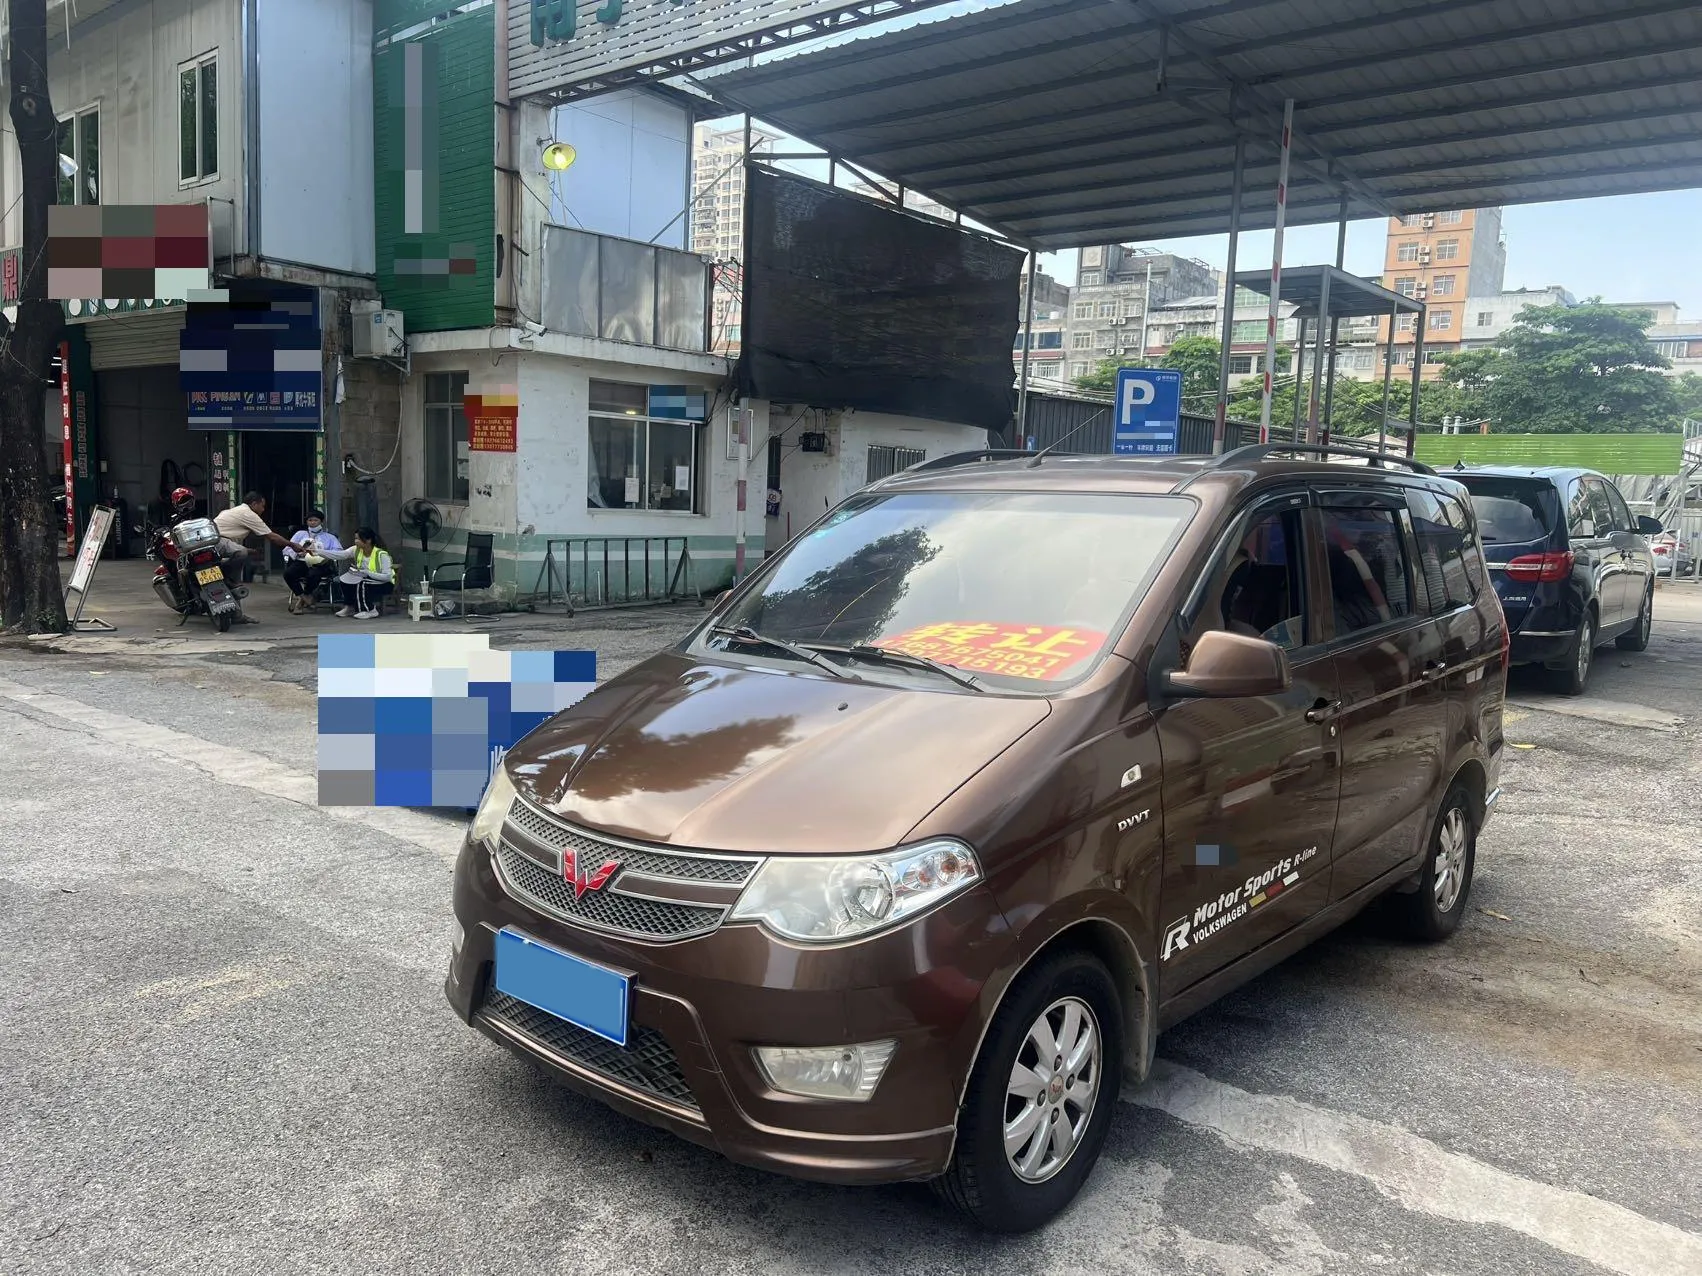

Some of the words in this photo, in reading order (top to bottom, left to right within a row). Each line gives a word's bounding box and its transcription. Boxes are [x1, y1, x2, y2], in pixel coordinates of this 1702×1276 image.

[1122, 379, 1155, 424] P
[1117, 809, 1150, 831] DVVT
[1192, 886, 1242, 928] Motor
[1243, 856, 1292, 897] Sports
[1293, 845, 1317, 867] R-line
[1160, 915, 1191, 962] R
[1193, 902, 1248, 944] VOLKSWAGEN
